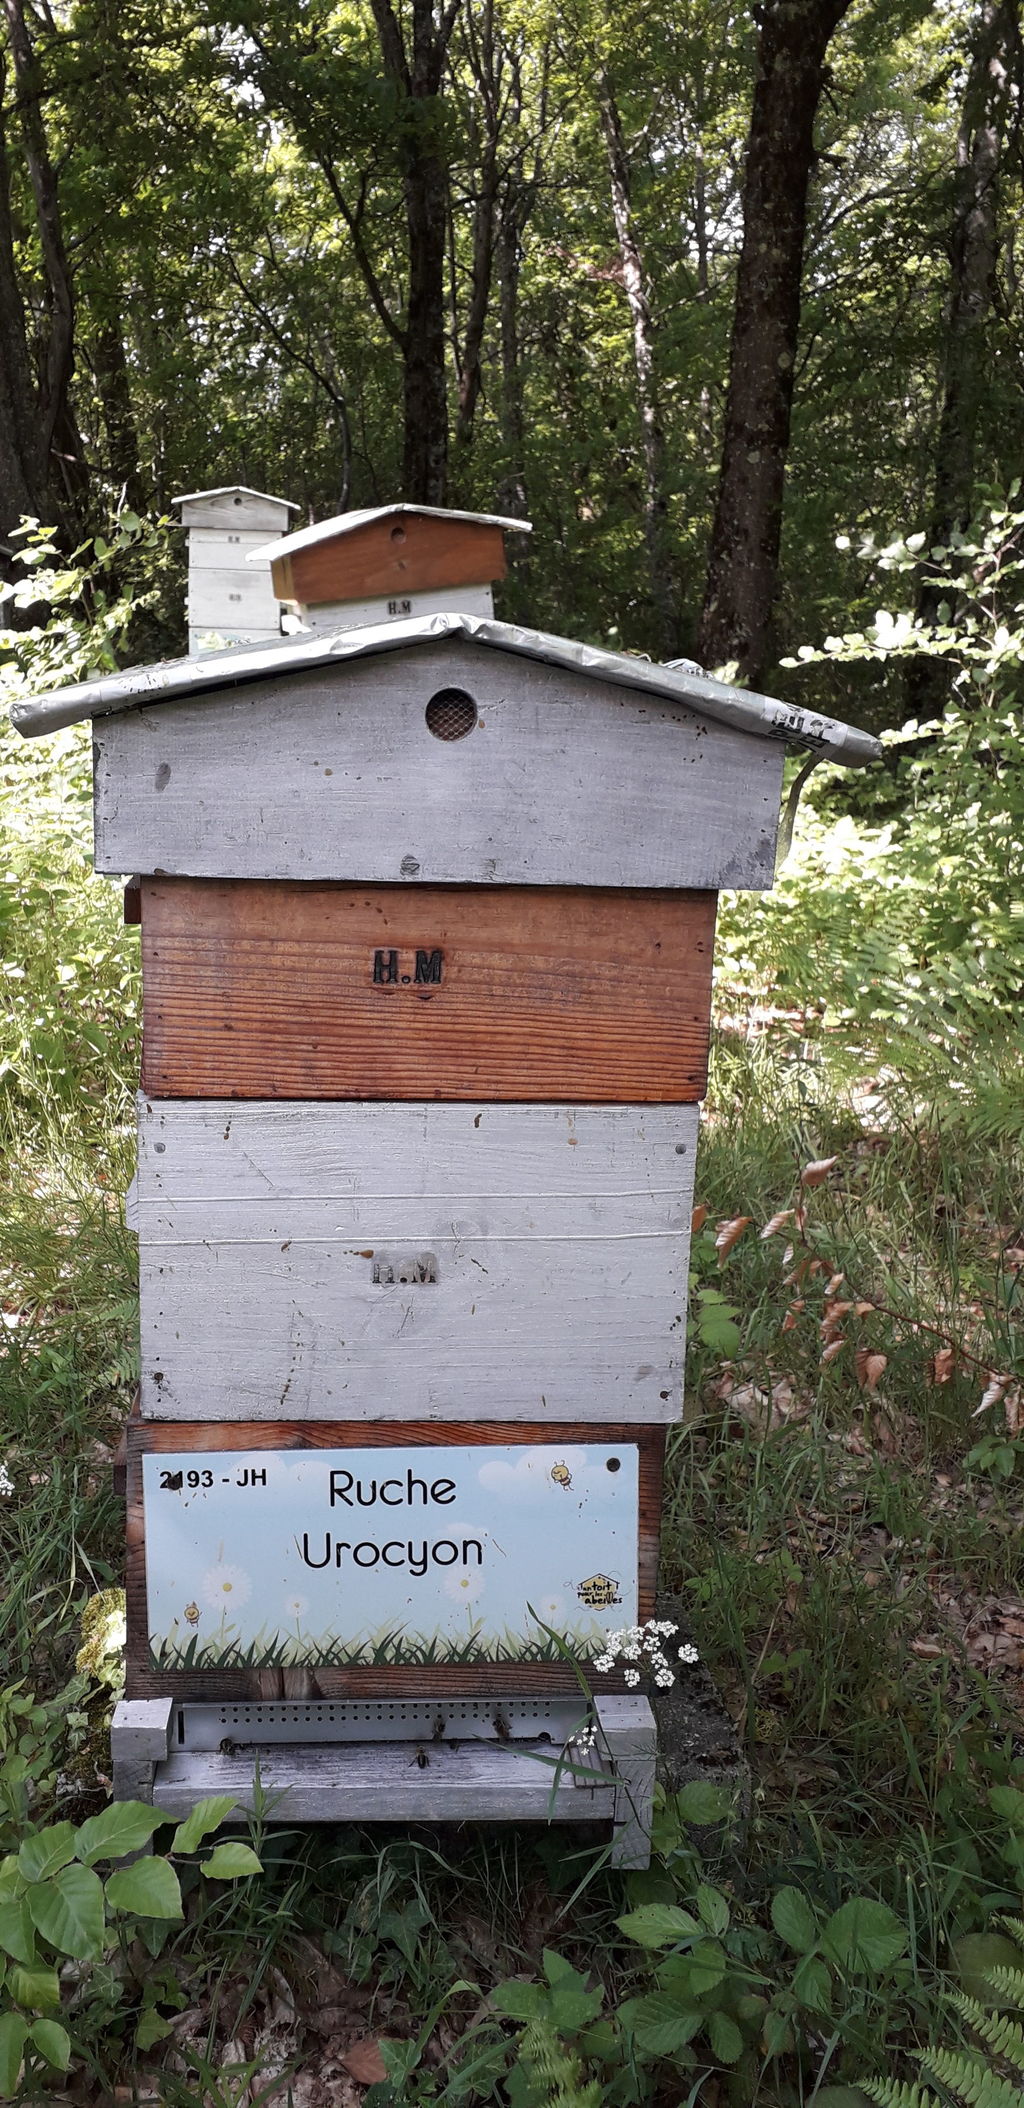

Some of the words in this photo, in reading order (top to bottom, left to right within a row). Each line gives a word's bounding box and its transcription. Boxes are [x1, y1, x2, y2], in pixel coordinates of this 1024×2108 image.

[388, 600, 411, 614] H.M
[373, 950, 443, 984] H.M
[236, 1468, 267, 1486] JH
[329, 1468, 457, 1507] Ruche
[303, 1532, 483, 1577] Urocyon
